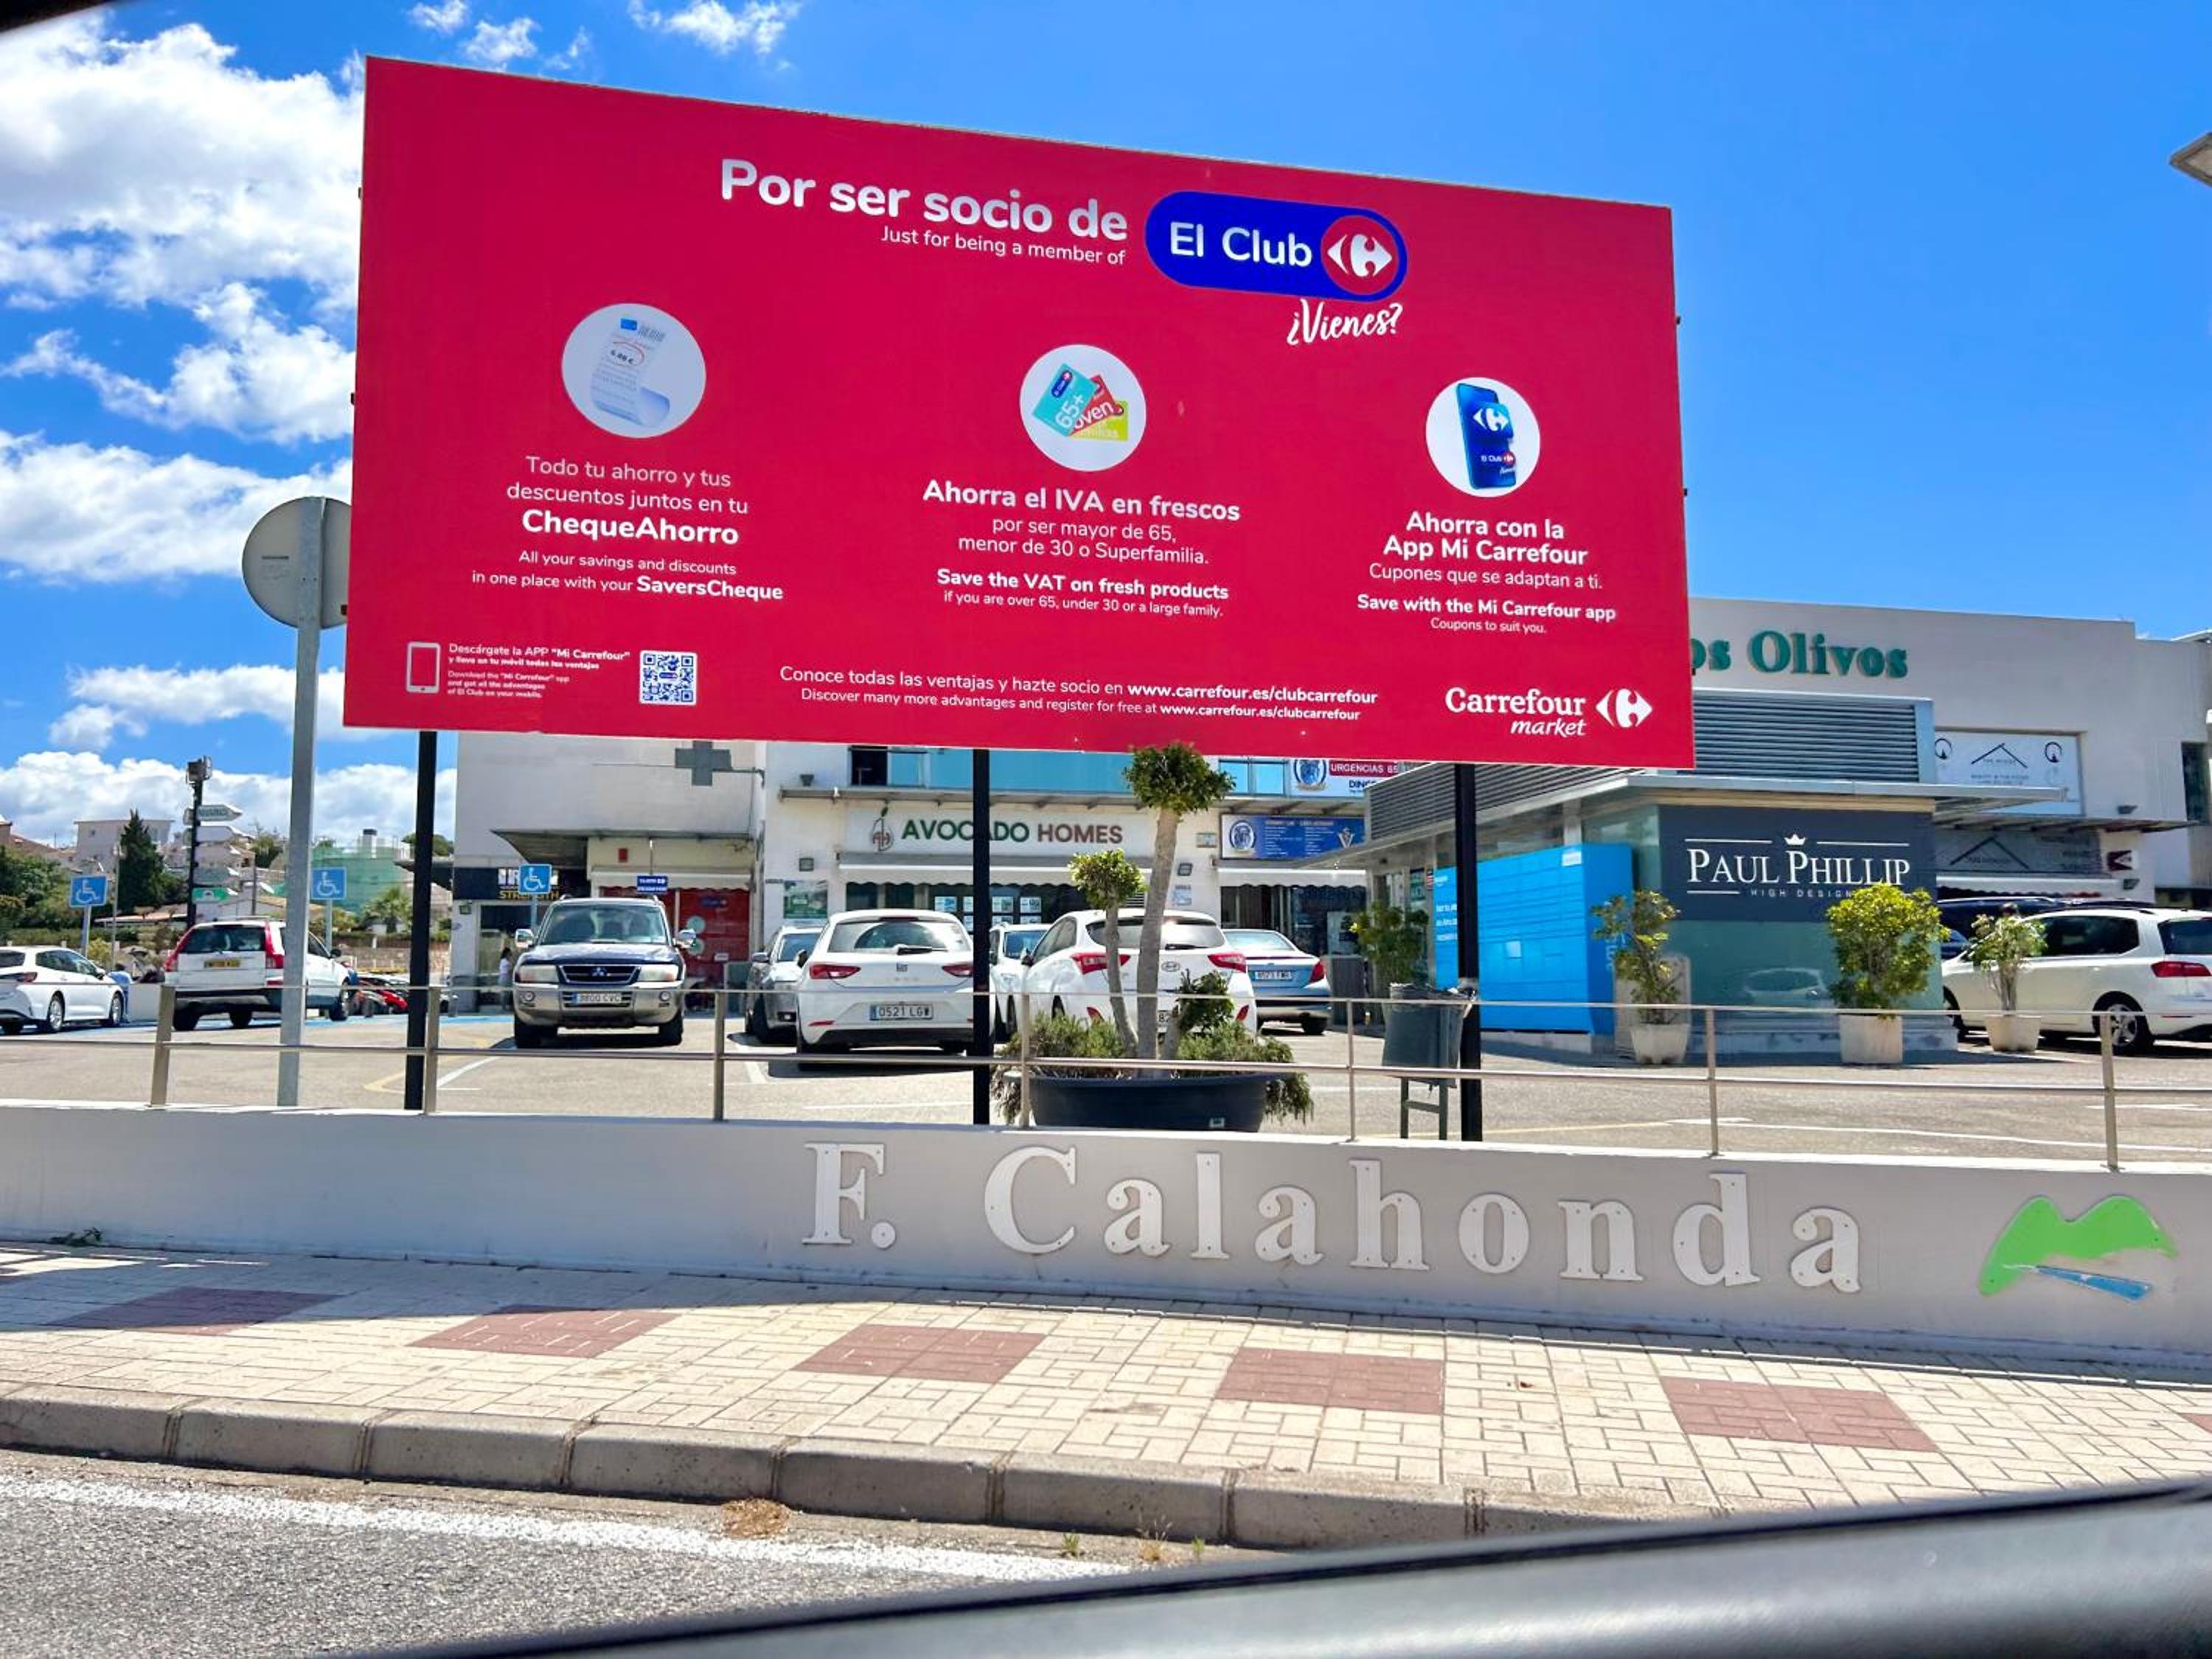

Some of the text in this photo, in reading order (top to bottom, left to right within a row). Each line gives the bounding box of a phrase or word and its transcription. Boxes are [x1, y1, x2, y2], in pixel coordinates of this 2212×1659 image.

[721, 159, 1127, 241] Por ser socio de
[881, 225, 1126, 265] Just for being a member of
[1170, 221, 1312, 268] El Club
[1287, 298, 1403, 346] ¿Vienes?
[1054, 394, 1084, 428] 65+
[525, 455, 731, 488] Todo tu ahorro y tus
[507, 481, 748, 515] descuentos juntos en tu
[922, 479, 1241, 521] Ahorra el IVA en frescos
[522, 509, 740, 545] ChequeAhorro
[992, 518, 1176, 543] por ser mayor de 65,
[1405, 510, 1565, 540] Ahorra con la
[518, 550, 737, 576] All your savings and discounts
[958, 537, 1208, 564] menor de 30 o Superfamilia.
[1382, 535, 1589, 566] App Mi Carrefour
[471, 570, 784, 602] in one place with your SaversCheque
[937, 568, 1229, 599] Save the VAT on fresh products
[1369, 562, 1603, 589] Cupones que se adaptan a ti.
[943, 589, 1223, 619] if you are over 65, under 30 or a large family.
[1357, 594, 1617, 623] Save with the Mi Carrefour app
[1430, 616, 1546, 635] Coupons to suit you.
[1747, 630, 1908, 679] Olivos
[779, 665, 1378, 704] Conoce todas las ventajas y hazte socio en www.carrefour.es/clubcarrefour
[801, 687, 1360, 720] Discover many more advantages and register for free at www.carrefour.es/clubcarrefour
[1444, 686, 1587, 716] Carrefour
[1510, 717, 1587, 738] market
[1330, 763, 1384, 774] URGENCIAS
[901, 819, 1124, 844] AVOCDO HOMES
[1750, 888, 1853, 899] HIGH DESIGN
[878, 1006, 905, 1017] 0521
[804, 1142, 1863, 1295] F. Calahonda
